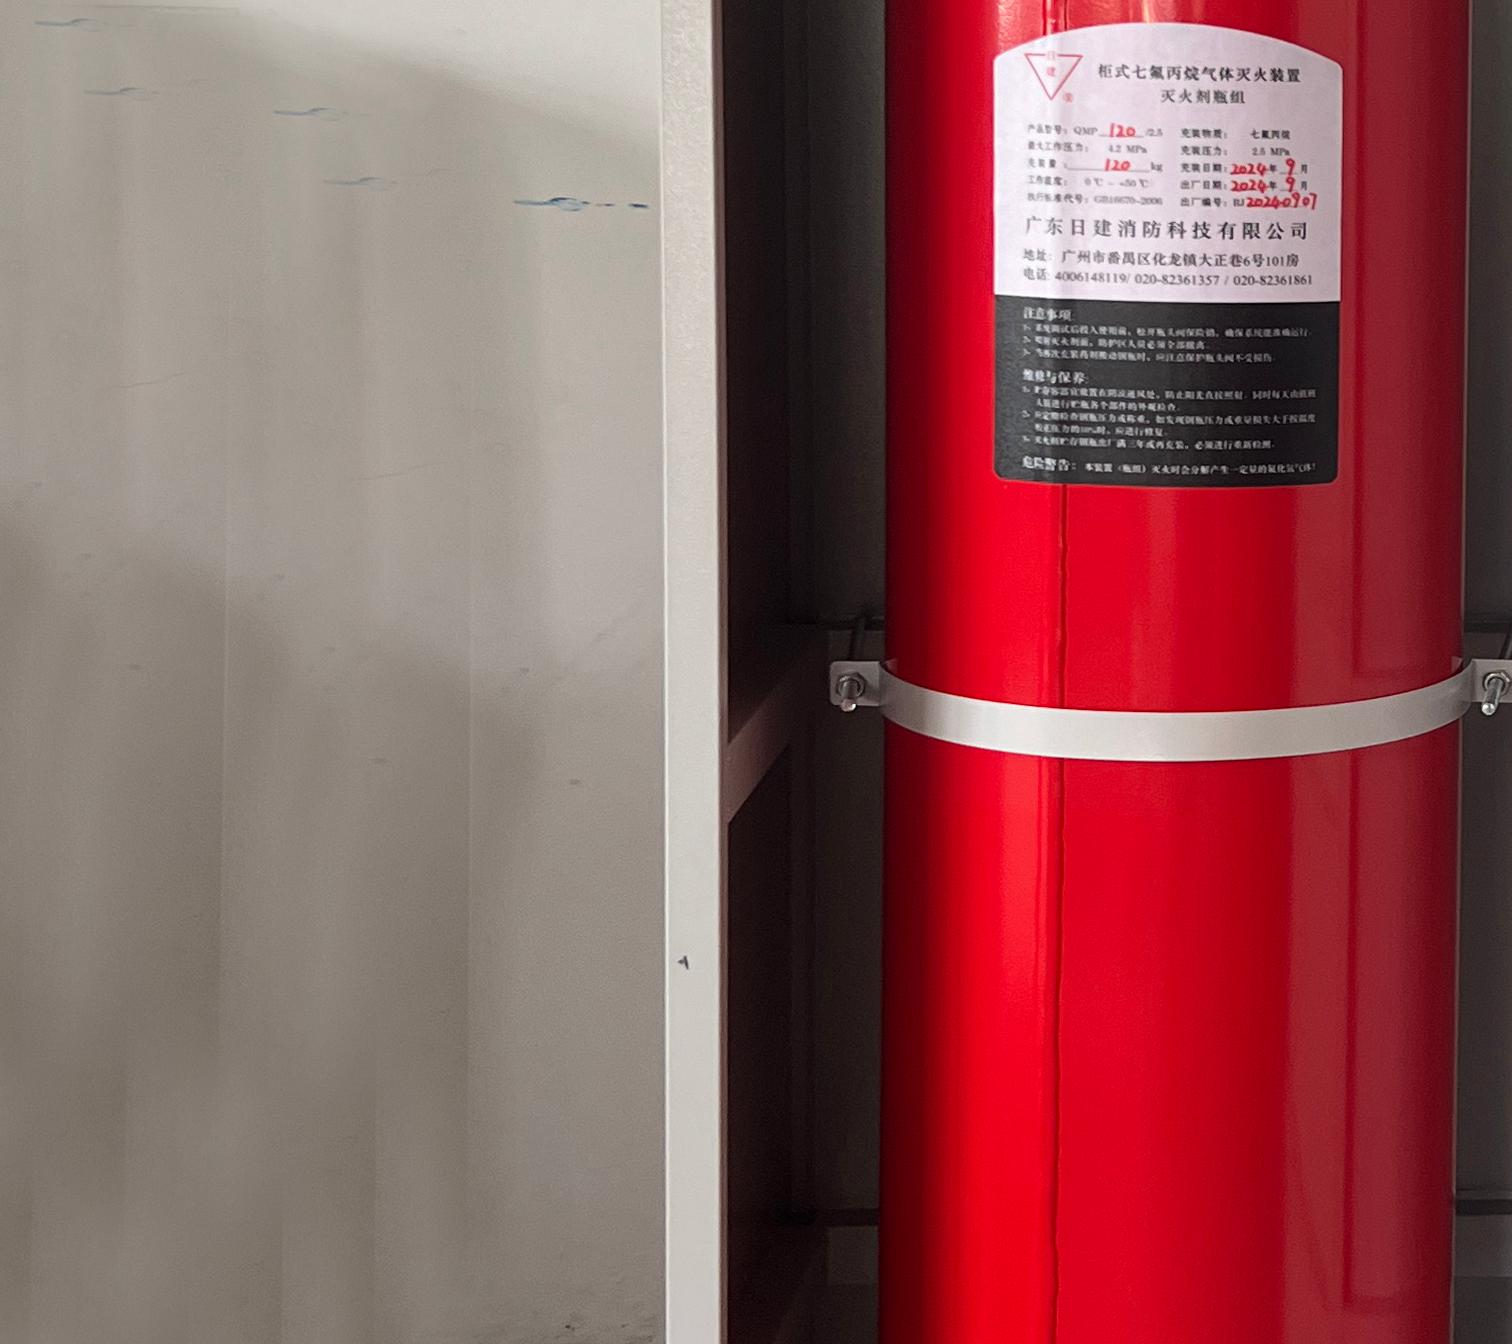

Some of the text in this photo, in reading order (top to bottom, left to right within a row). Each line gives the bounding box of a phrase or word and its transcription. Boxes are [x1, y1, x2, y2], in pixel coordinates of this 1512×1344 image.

[1098, 63, 1301, 83] 柜式七氟丙烷气体灭火装置
[1160, 88, 1246, 105] 灭火剂瓶组
[1109, 122, 1137, 137] 120
[1104, 158, 1131, 172] 120
[1025, 215, 1307, 241] 广东日建消防科技有限公司
[1233, 274, 1312, 286] 020-82361861
